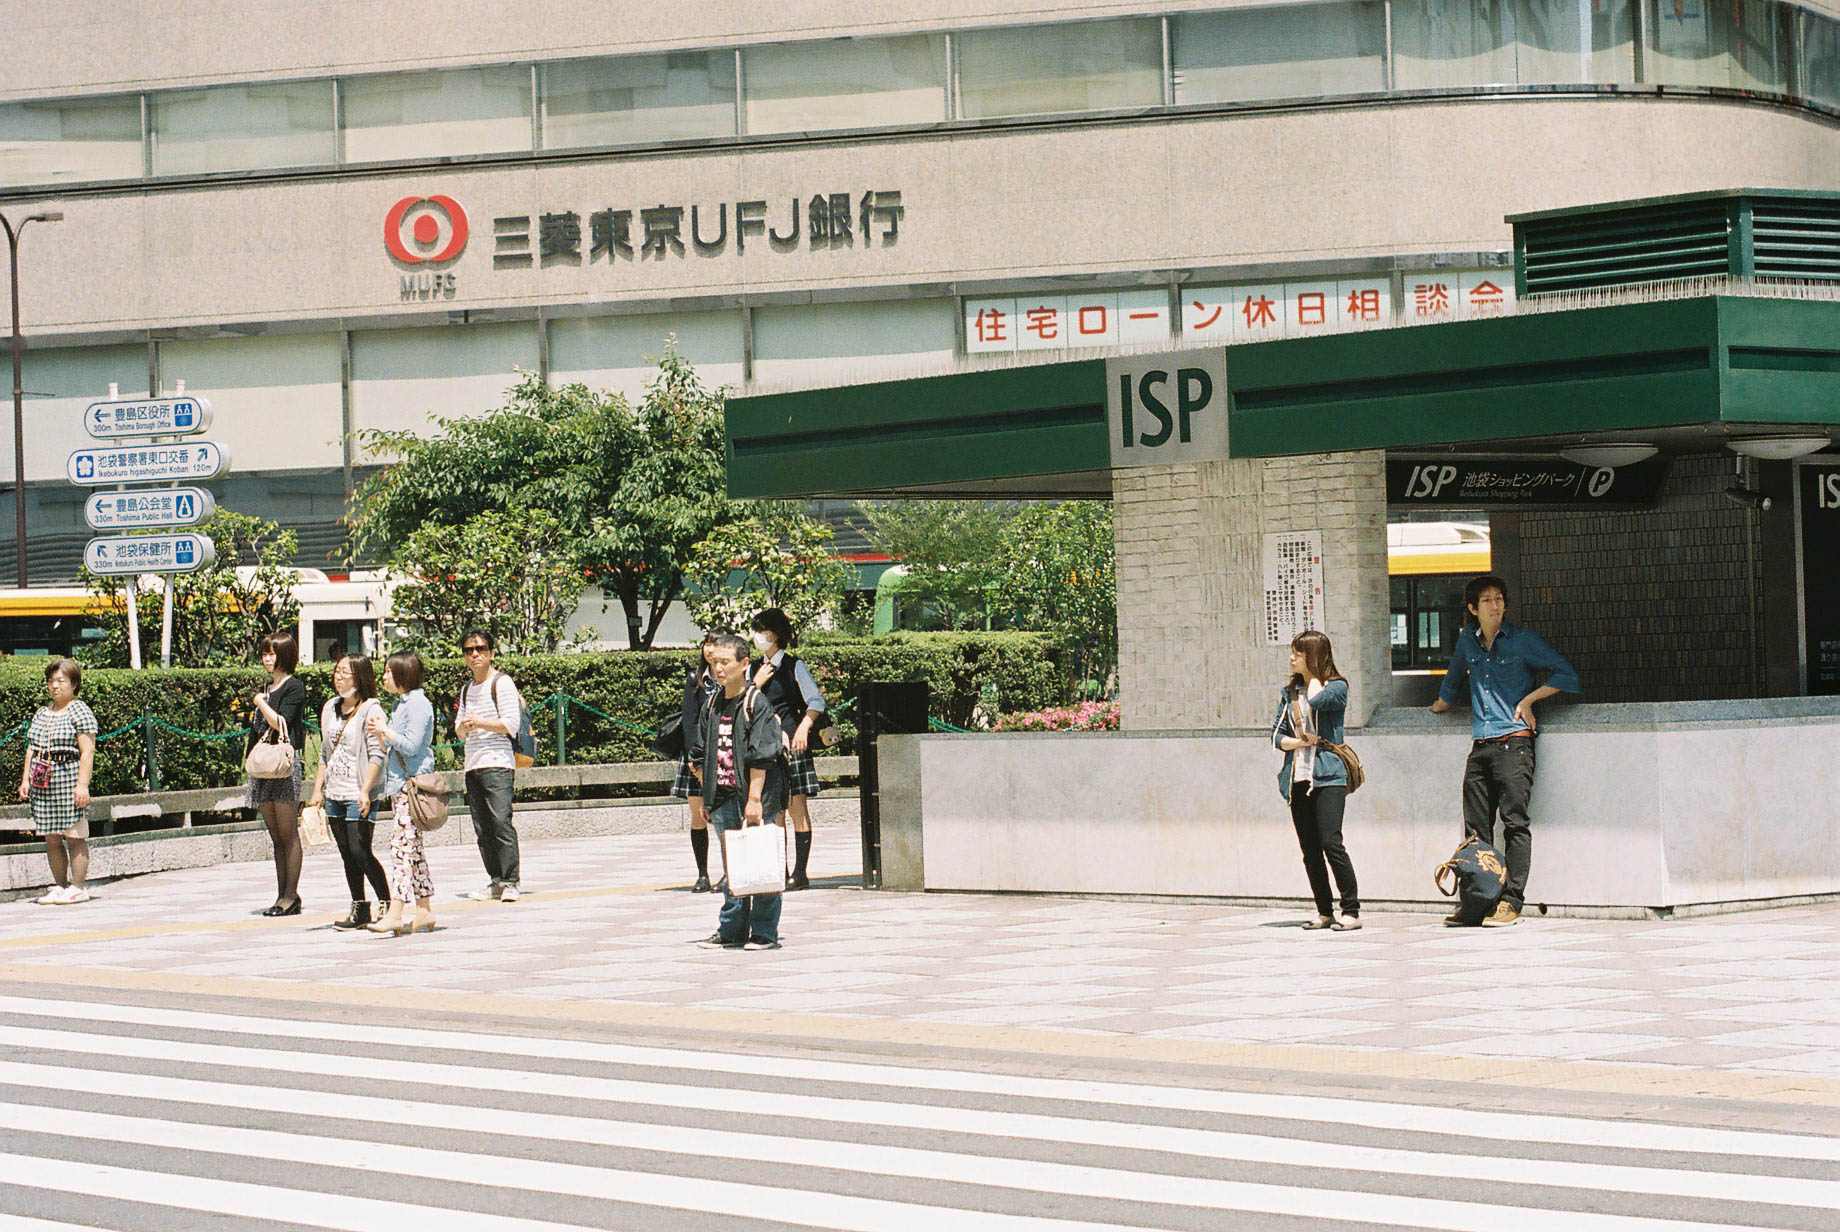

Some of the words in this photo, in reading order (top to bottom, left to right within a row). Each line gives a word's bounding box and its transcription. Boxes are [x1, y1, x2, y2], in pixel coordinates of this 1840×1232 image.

[493, 190, 905, 269] 三菱東京UFJ銀行
[974, 280, 1504, 342] 住宅ローン休日相談会
[115, 405, 170, 421] 豊島区役所
[1120, 367, 1213, 448] ISP
[93, 423, 112, 432] 300m
[115, 422, 134, 431] Toshima
[135, 421, 155, 430] Borough
[157, 419, 171, 429] Office
[97, 450, 189, 468] 池袋警察署東口交番
[98, 467, 128, 477] Ikebukuro
[169, 464, 189, 474] Koban
[193, 463, 212, 472] 120m
[1404, 466, 1457, 497] ISP
[1462, 471, 1575, 488] 池袋ショッピングパーク
[116, 496, 172, 512] 豊島公会堂
[94, 514, 112, 523] 330m
[116, 513, 140, 522] Toshima
[141, 512, 160, 521] Public
[161, 511, 173, 520] Hall
[116, 542, 171, 557] 池袋保健所
[94, 560, 112, 569] 330m
